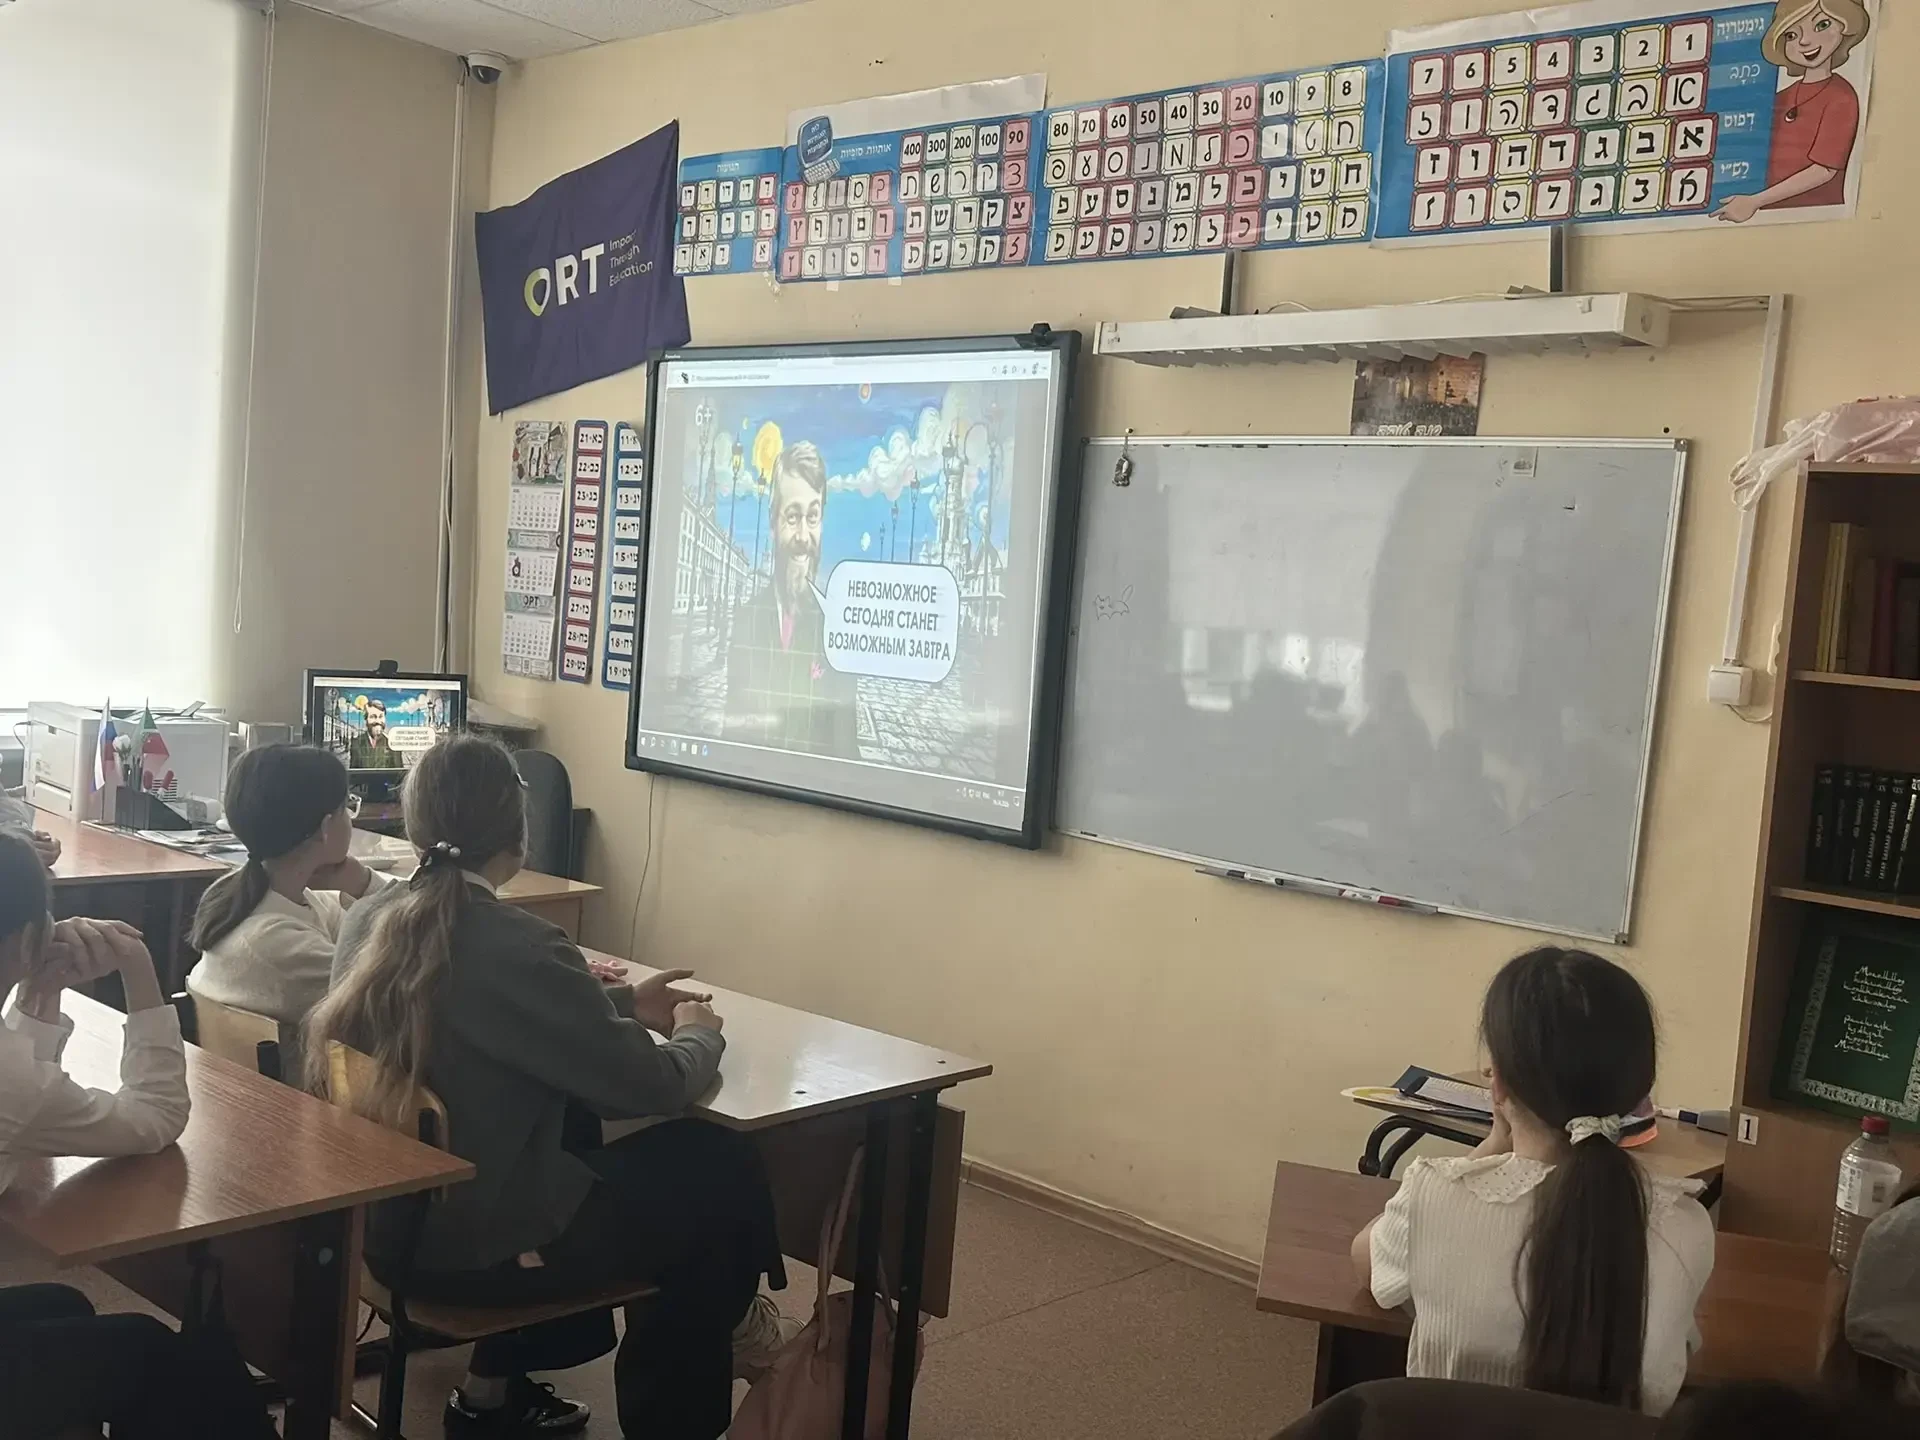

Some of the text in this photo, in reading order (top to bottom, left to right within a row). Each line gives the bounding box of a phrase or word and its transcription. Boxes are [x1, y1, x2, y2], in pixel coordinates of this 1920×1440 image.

[1593, 46, 1603, 62] 3
[1638, 40, 1648, 56] 2
[1465, 62, 1475, 78] 6
[1507, 57, 1516, 73] 5
[1547, 51, 1559, 70] 4
[1424, 68, 1434, 84] 7
[1053, 81, 1351, 137] 8 9 10 20 30 40 50 60 70 80
[904, 131, 1023, 155] 90 100 200 300 400
[1679, 126, 1704, 150] א
[524, 243, 605, 316] ORT
[696, 404, 711, 425] 6+
[848, 580, 937, 603] НЕВОЗМОЖНОЕ
[843, 606, 938, 631] СЕГОДНЯ СТАНЕТ
[828, 632, 950, 661] ВОЗМОЖНЫМ ЗАВТРА
